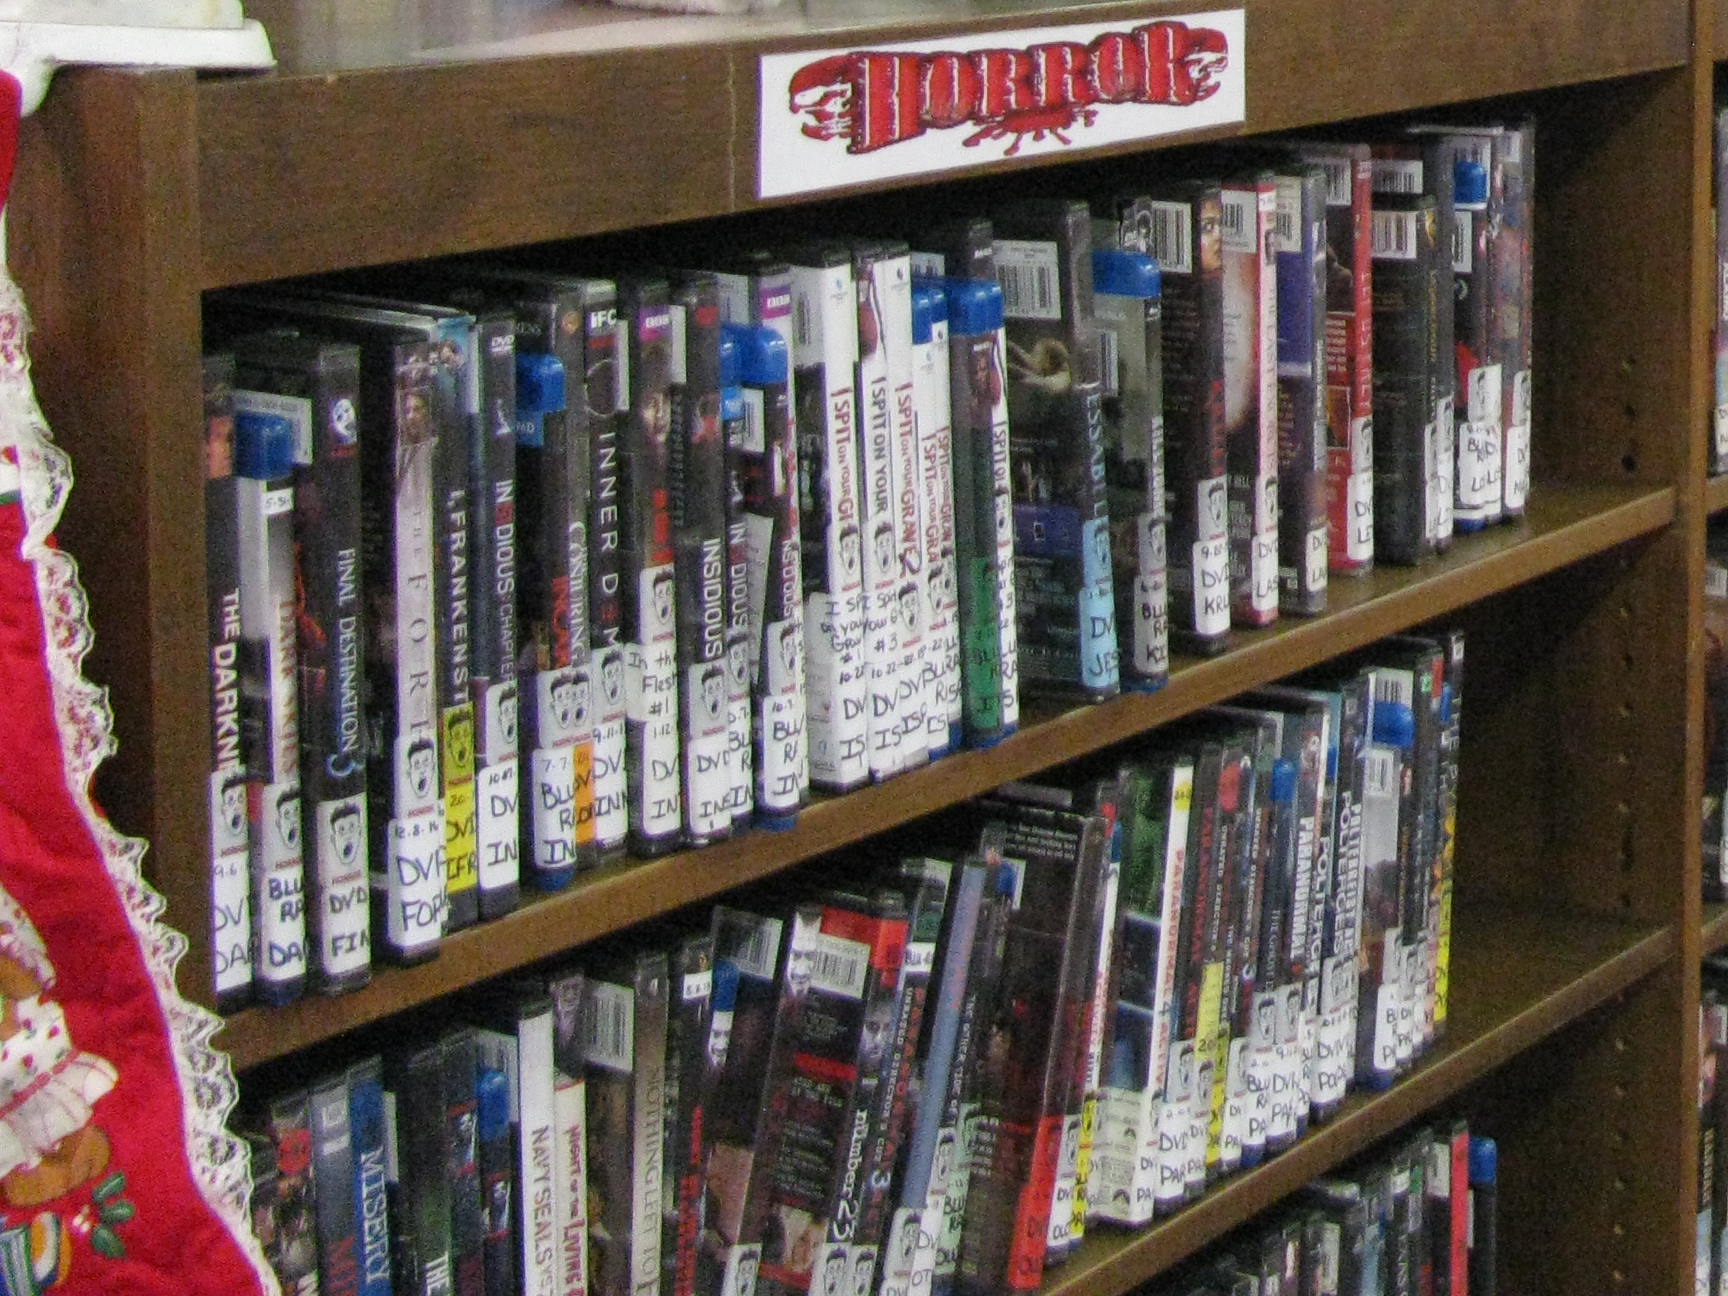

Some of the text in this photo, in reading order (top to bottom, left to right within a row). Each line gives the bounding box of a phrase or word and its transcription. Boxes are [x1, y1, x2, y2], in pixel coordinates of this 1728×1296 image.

[848, 20, 1197, 154] HORROR
[834, 401, 851, 444] SPIT
[873, 387, 887, 431] SPIT
[897, 395, 914, 440] SPIT
[874, 433, 886, 459] ON
[924, 443, 939, 481] SPIT
[598, 431, 618, 553] INNER
[874, 465, 888, 514] YOUR
[338, 548, 357, 607] FINAL
[450, 510, 470, 703] FRANKENST
[702, 537, 722, 659] INSIDIOUS
[222, 588, 241, 644] THE
[338, 616, 361, 753] DESTINATION
[487, 840, 517, 867] IN
[1332, 790, 1353, 954] POLTERGEIS
[328, 889, 368, 914] DVD
[1289, 815, 1315, 961] PARANORMAL
[562, 1124, 582, 1175] NIGHT
[645, 1064, 665, 1185] NOTHING
[530, 1125, 551, 1187] NAVY
[360, 1147, 390, 1286] MISERY
[534, 1187, 554, 1265] SEALS
[562, 1217, 587, 1290] LIVING
